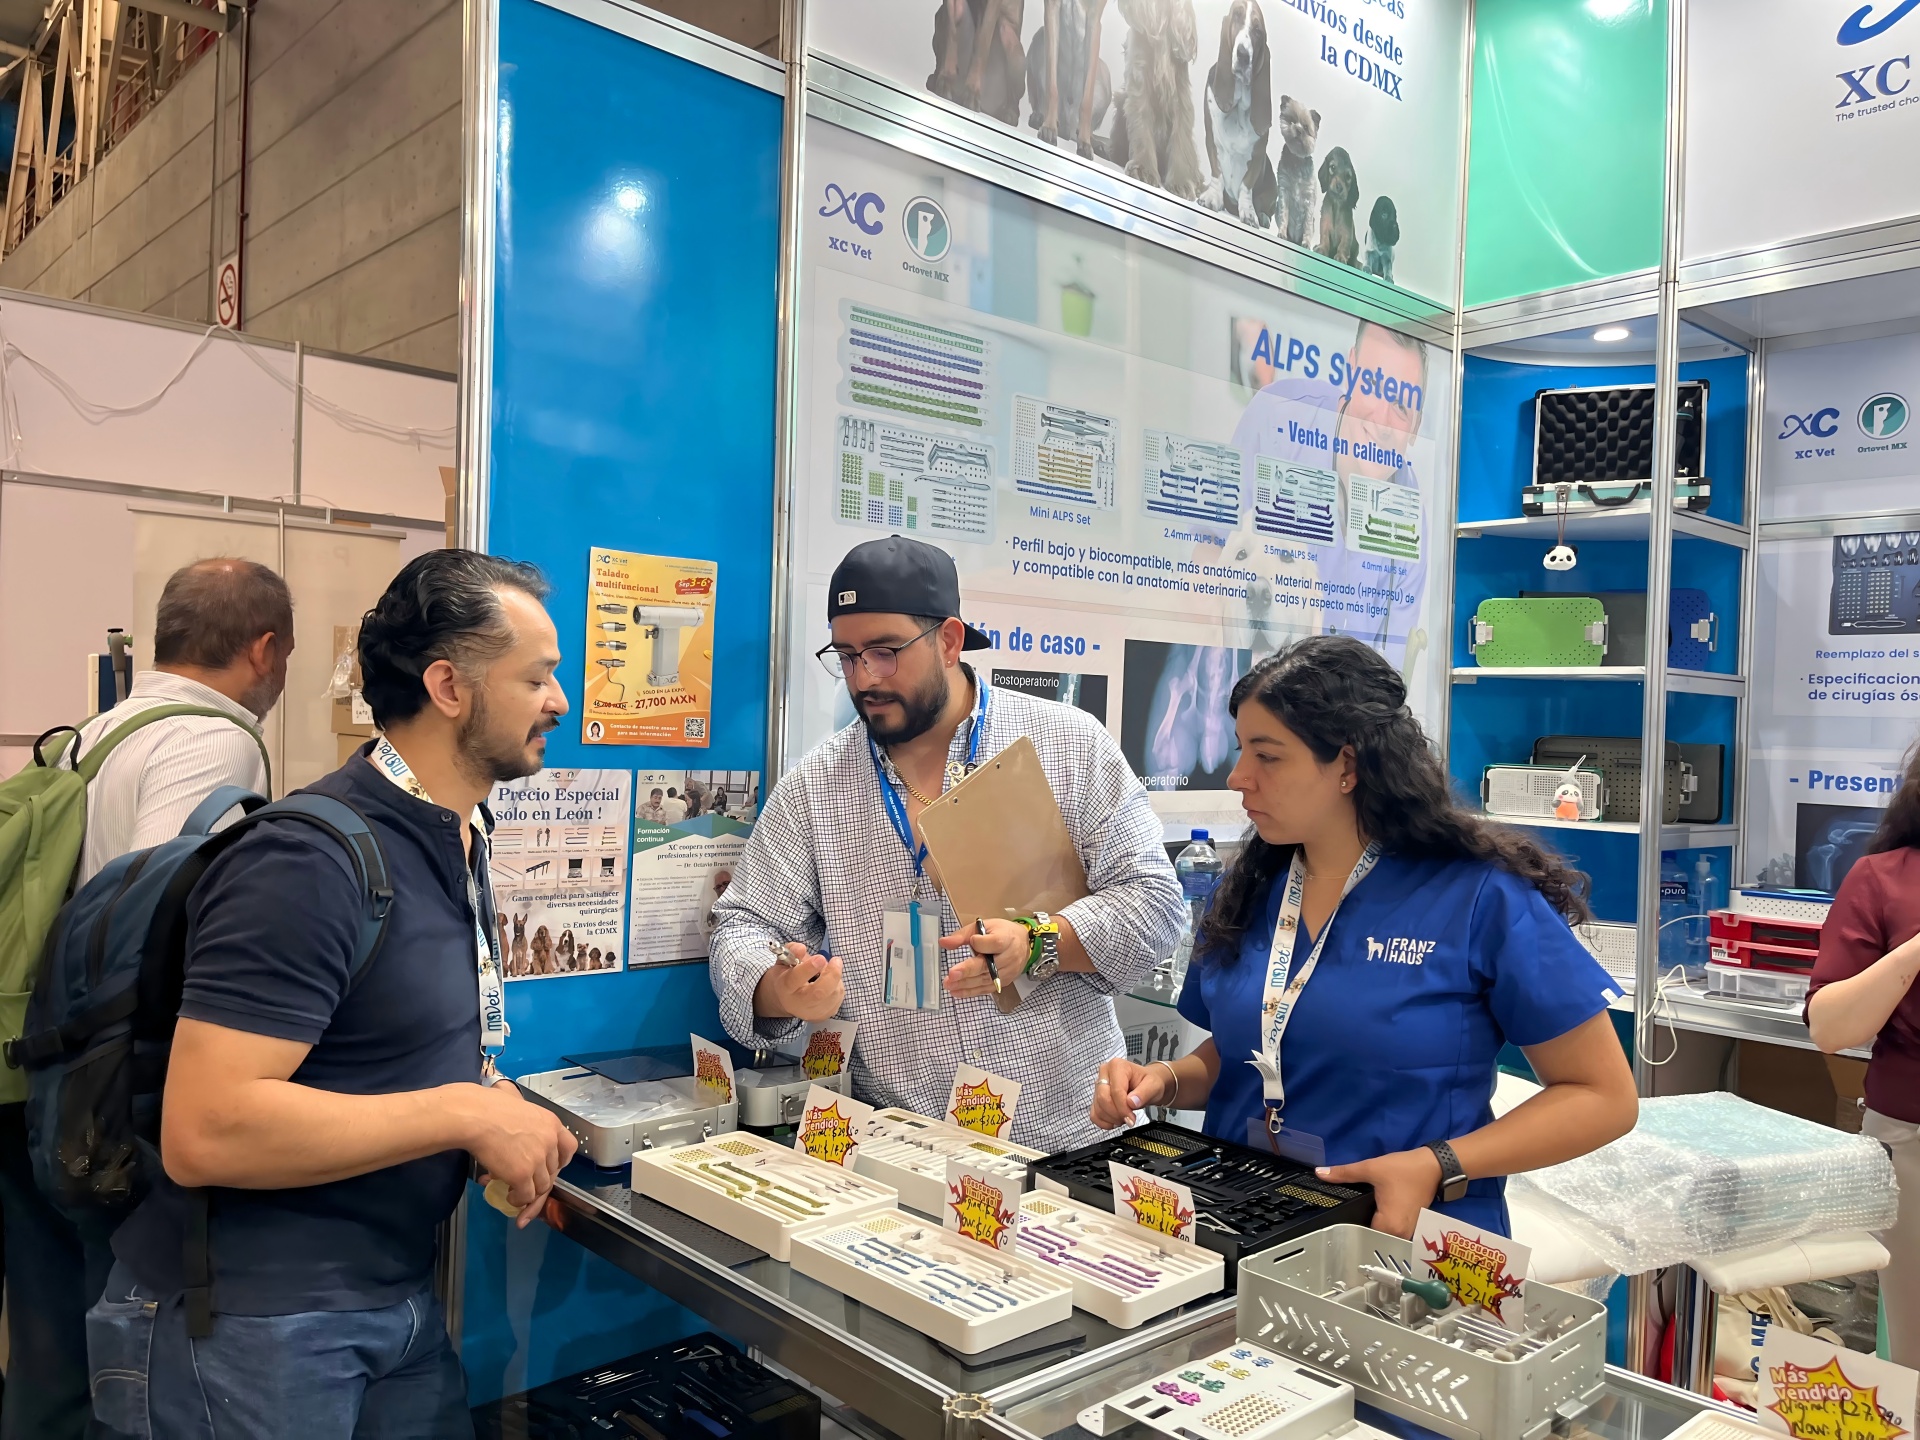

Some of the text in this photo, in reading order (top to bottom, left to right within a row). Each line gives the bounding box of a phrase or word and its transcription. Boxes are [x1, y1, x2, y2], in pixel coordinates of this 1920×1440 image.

[1353, 18, 1403, 66] desde
[1321, 35, 1402, 101] la CDMX
[1835, 55, 1910, 109] XC
[1836, 96, 1920, 122] The trusted cho
[829, 236, 872, 260] XC Vet
[902, 261, 949, 283] Ortovet MX
[1251, 328, 1422, 412] ALPS System
[1288, 420, 1403, 469] Venta en caliente
[1857, 442, 1908, 453] Ortovet MX
[1794, 448, 1836, 460] XC Vet
[1029, 505, 1091, 526] Mini ALPS Set
[1164, 527, 1226, 546] 2.4mm ALPS Set
[1012, 536, 1257, 582] Perfil bajo y biocompatible, más anatómico
[1289, 547, 1306, 560] ALPS
[1307, 552, 1318, 562] Set
[596, 568, 630, 579] Taladro
[1012, 559, 1249, 599] y compatible con la anatomía veterinaria.
[595, 580, 660, 594] multifuncional
[1275, 573, 1415, 605] Material mejorado (HPP+PPSU) de
[1275, 594, 1299, 609] cajas
[1302, 597, 1308, 609] y
[1309, 598, 1344, 615] aspecto
[1346, 601, 1364, 613] más
[1008, 626, 1033, 652] de
[1040, 632, 1086, 656] caso
[1815, 649, 1920, 661] Reemplazo del s
[993, 673, 1060, 688] Postoperatorio
[1808, 673, 1920, 687] Especificacion
[635, 696, 666, 709] 27,700
[670, 694, 696, 705] MXN
[1808, 689, 1920, 704] de cirugías ós
[1138, 773, 1189, 788] operatorio
[1808, 770, 1904, 793] Present
[498, 788, 619, 804] Precio Especial
[495, 807, 528, 821] sólo
[532, 810, 550, 820] en
[555, 807, 593, 820] León
[658, 851, 697, 860] profesionales
[704, 850, 742, 858] experimenta
[535, 893, 567, 901] completa
[569, 893, 584, 901] para
[580, 907, 618, 916] quirúrgicas
[1391, 938, 1436, 953] FRANZ
[1389, 950, 1423, 965] HAUS
[956, 1084, 973, 1097] Más
[956, 1094, 990, 1107] vendido
[806, 1108, 822, 1120] Más
[805, 1118, 839, 1131] vendido
[1447, 1232, 1506, 1263] ¡Descuento
[1449, 1243, 1498, 1272] limitado!
[1769, 1364, 1809, 1384] Más
[1774, 1383, 1853, 1402] vendido
[1792, 1419, 1830, 1436] Now:
